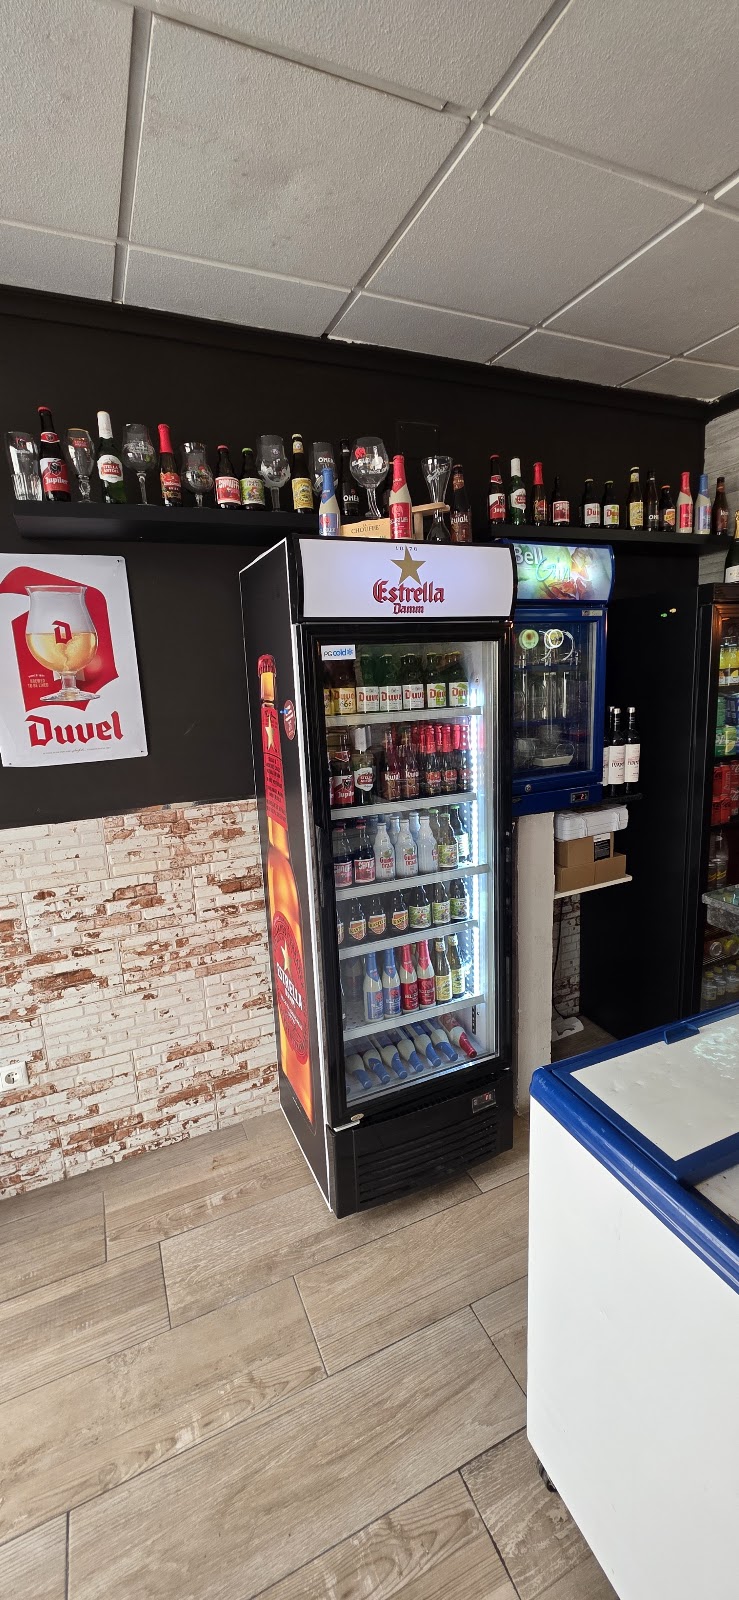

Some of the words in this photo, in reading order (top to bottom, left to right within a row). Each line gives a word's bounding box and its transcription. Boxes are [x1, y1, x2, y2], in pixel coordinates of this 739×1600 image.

[372, 578, 446, 604] Estrella
[392, 603, 425, 615] Damm
[25, 711, 124, 748] Duvel
